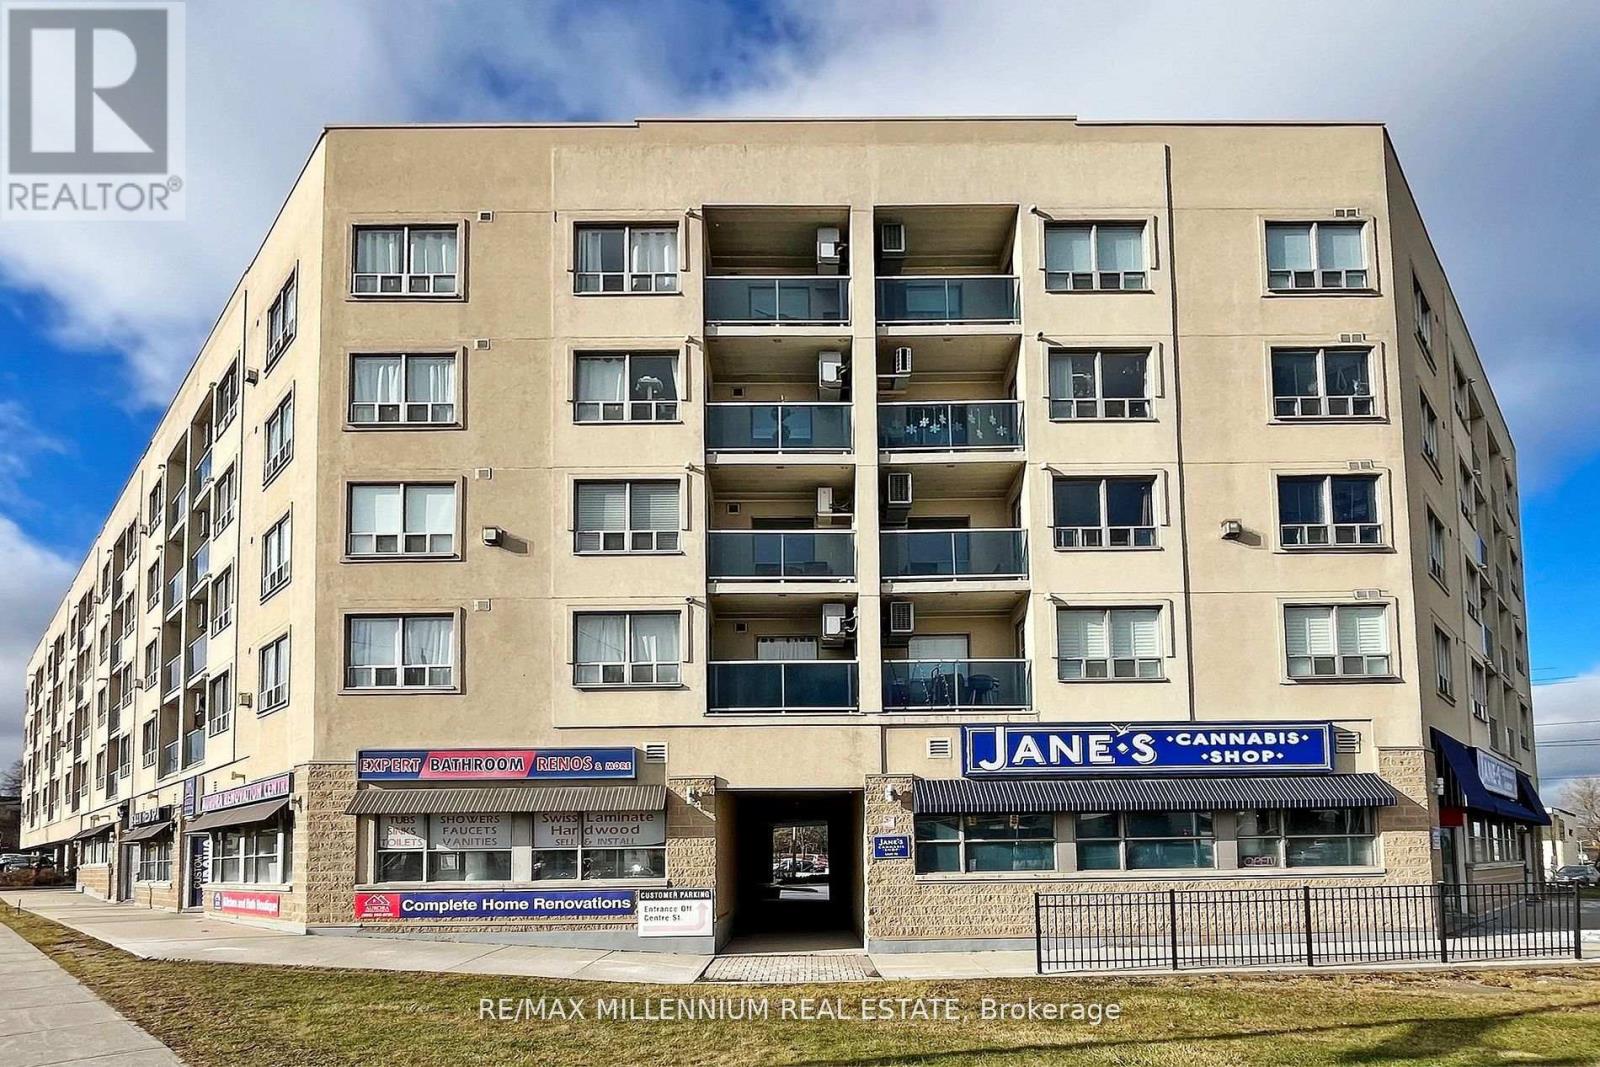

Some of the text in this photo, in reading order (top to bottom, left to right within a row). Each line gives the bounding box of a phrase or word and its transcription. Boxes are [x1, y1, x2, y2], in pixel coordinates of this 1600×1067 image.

[1175, 732, 1300, 745] CANNABIS
[1209, 750, 1275, 763] SHOP
[361, 756, 631, 772] EXPERT BATHROOM RENOS & MORE
[389, 815, 416, 824] TUBS
[440, 815, 501, 824] SHOWERS
[542, 812, 654, 823] Swiss Laminate
[443, 826, 497, 835] FAUCETS
[382, 838, 424, 847] TOILETS
[443, 838, 498, 846] VANITIES
[555, 837, 635, 846] SELL & INSTALL
[1244, 856, 1277, 867] OPEN
[193, 854, 203, 889] CUSTOM
[640, 890, 710, 899] CUSTOMER PARKING
[402, 897, 631, 914] Complete Home Renovations
